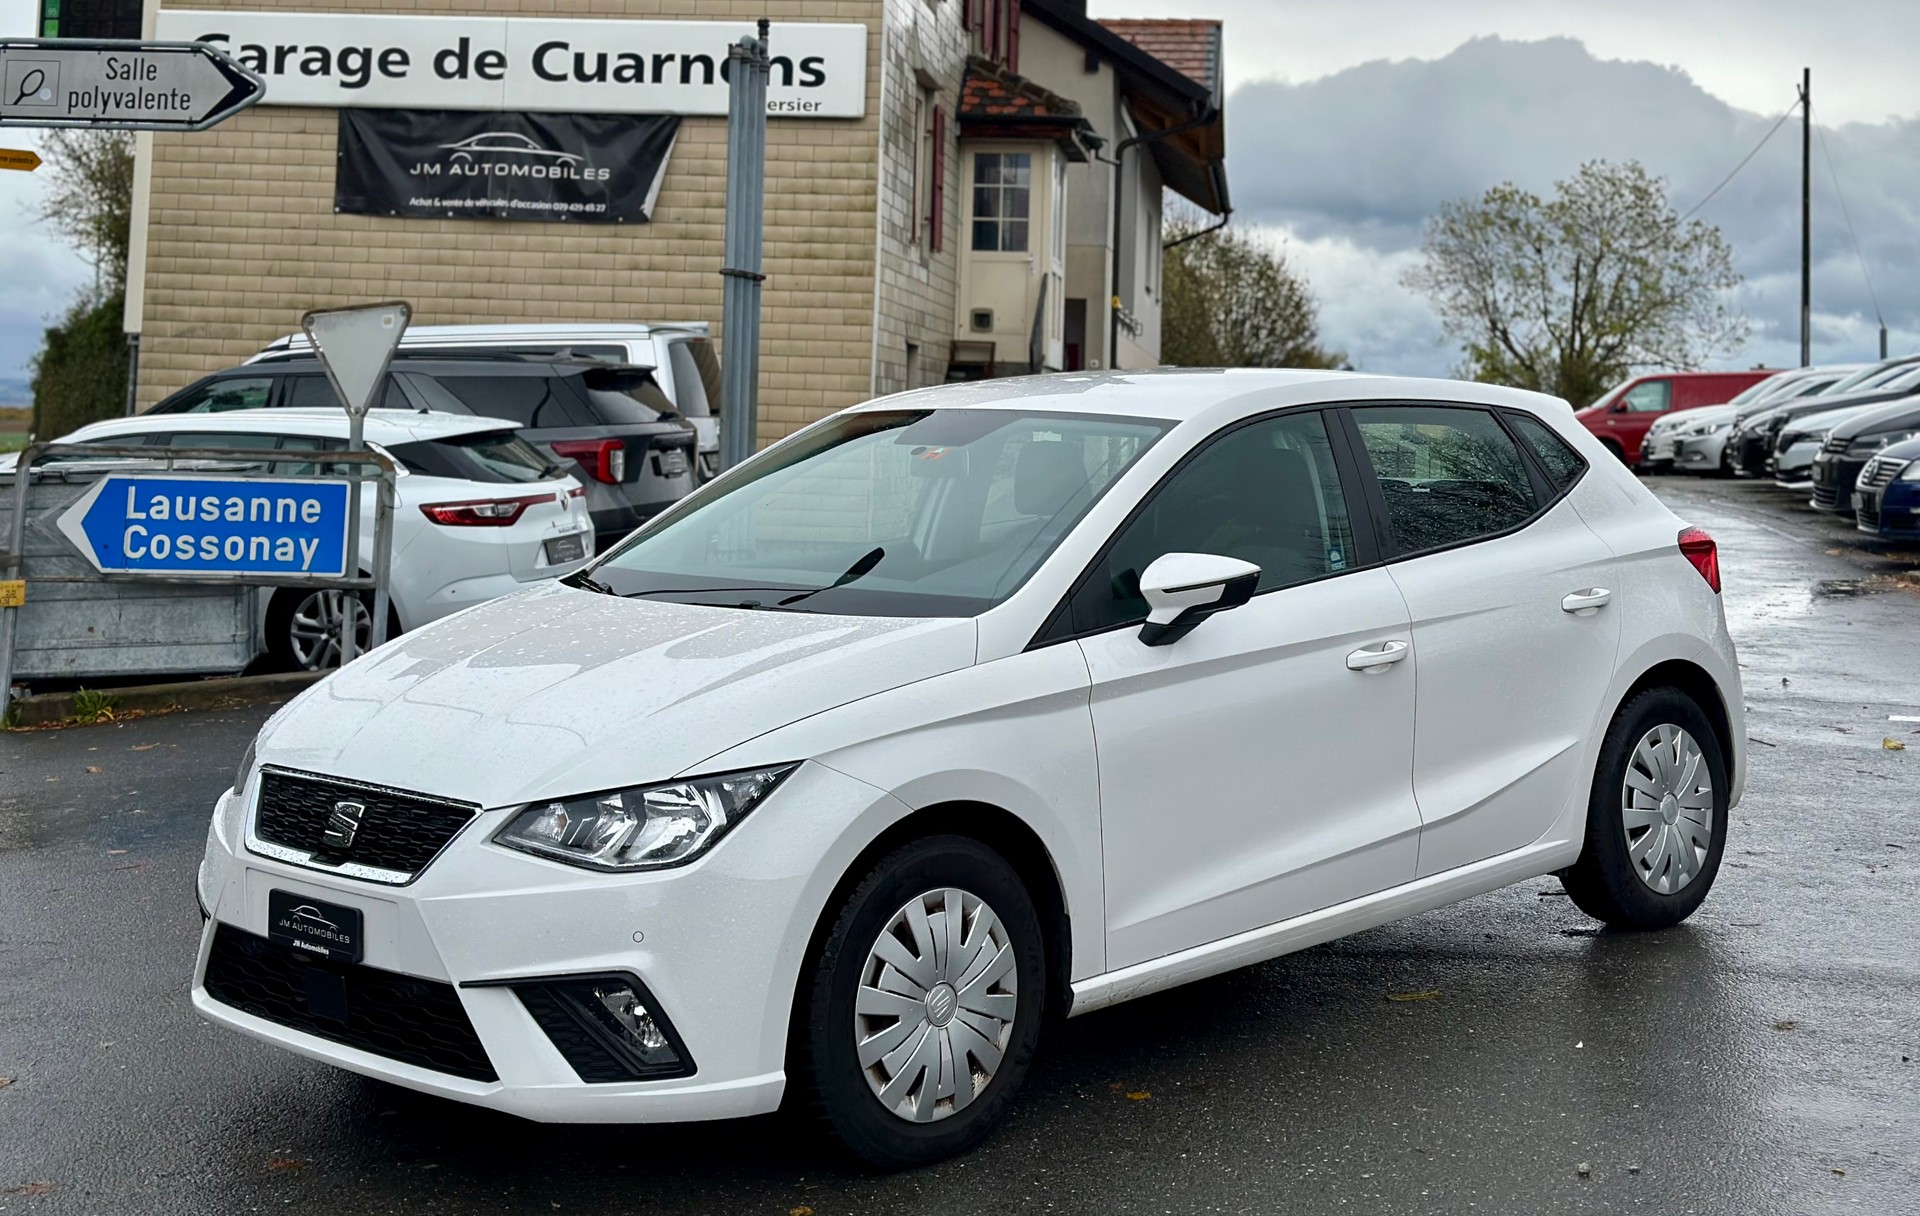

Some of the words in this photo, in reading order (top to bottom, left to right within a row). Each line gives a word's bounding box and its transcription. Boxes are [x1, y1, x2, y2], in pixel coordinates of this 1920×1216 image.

[105, 57, 158, 81] Salle
[433, 37, 508, 80] de
[531, 41, 826, 87] Cuarnns
[67, 86, 191, 115] polyvalente
[409, 163, 441, 175] JM
[450, 163, 611, 180] AUTOMOBILES
[409, 197, 432, 207] Achat
[442, 199, 463, 208] vente
[464, 198, 474, 208] de
[126, 486, 321, 524] Lausanne
[123, 525, 320, 571] Cossonay
[279, 919, 291, 928] JM
[292, 922, 350, 944] AUTOMOBILES
[301, 941, 330, 955] Automobiles
